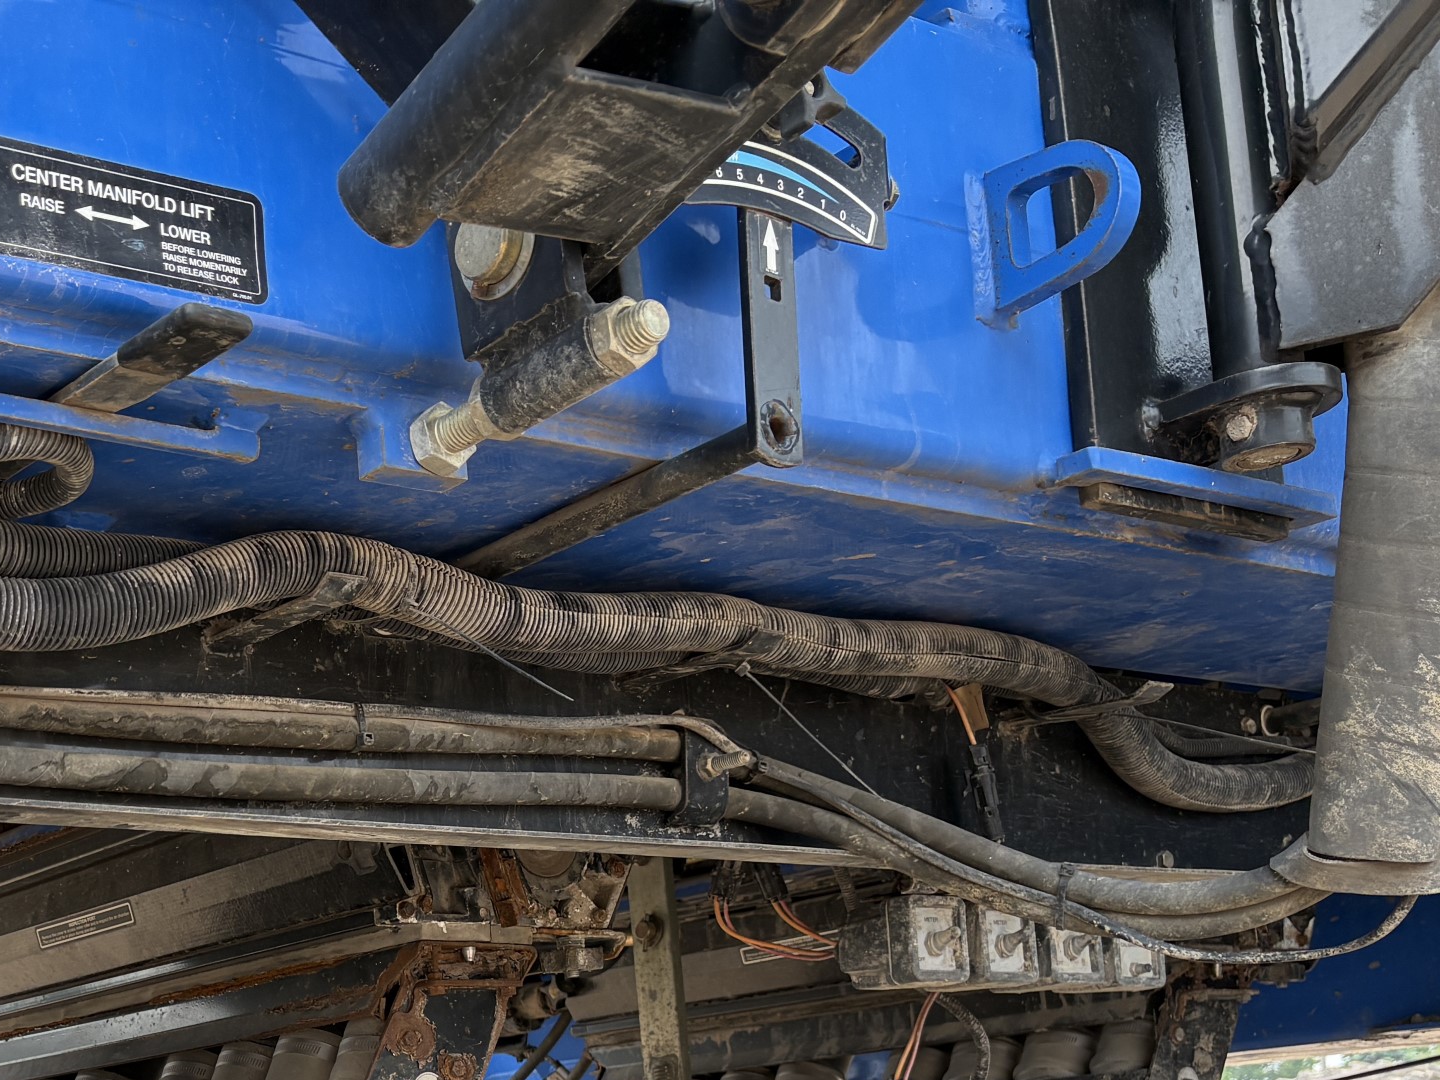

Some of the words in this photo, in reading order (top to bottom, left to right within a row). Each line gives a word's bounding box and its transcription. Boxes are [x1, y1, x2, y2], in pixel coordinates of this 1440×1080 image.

[11, 163, 84, 193] CENTER
[87, 180, 177, 213] MANIFOLD
[180, 200, 215, 221] LIFT
[20, 192, 66, 215] RAISE
[736, 168, 744, 180] 5
[757, 173, 764, 185] 4
[777, 179, 784, 191] 3
[797, 187, 804, 199] 2
[820, 199, 826, 210] 1
[839, 210, 847, 221] 0
[160, 223, 212, 246] LOWER
[161, 241, 196, 256] BEFORE
[197, 249, 242, 265] LOWERING
[162, 252, 188, 265] RAISE
[189, 257, 247, 277] MOMENTARILY
[163, 262, 176, 272] TO
[177, 266, 215, 280] RELEASE
[216, 273, 240, 285] LOCK
